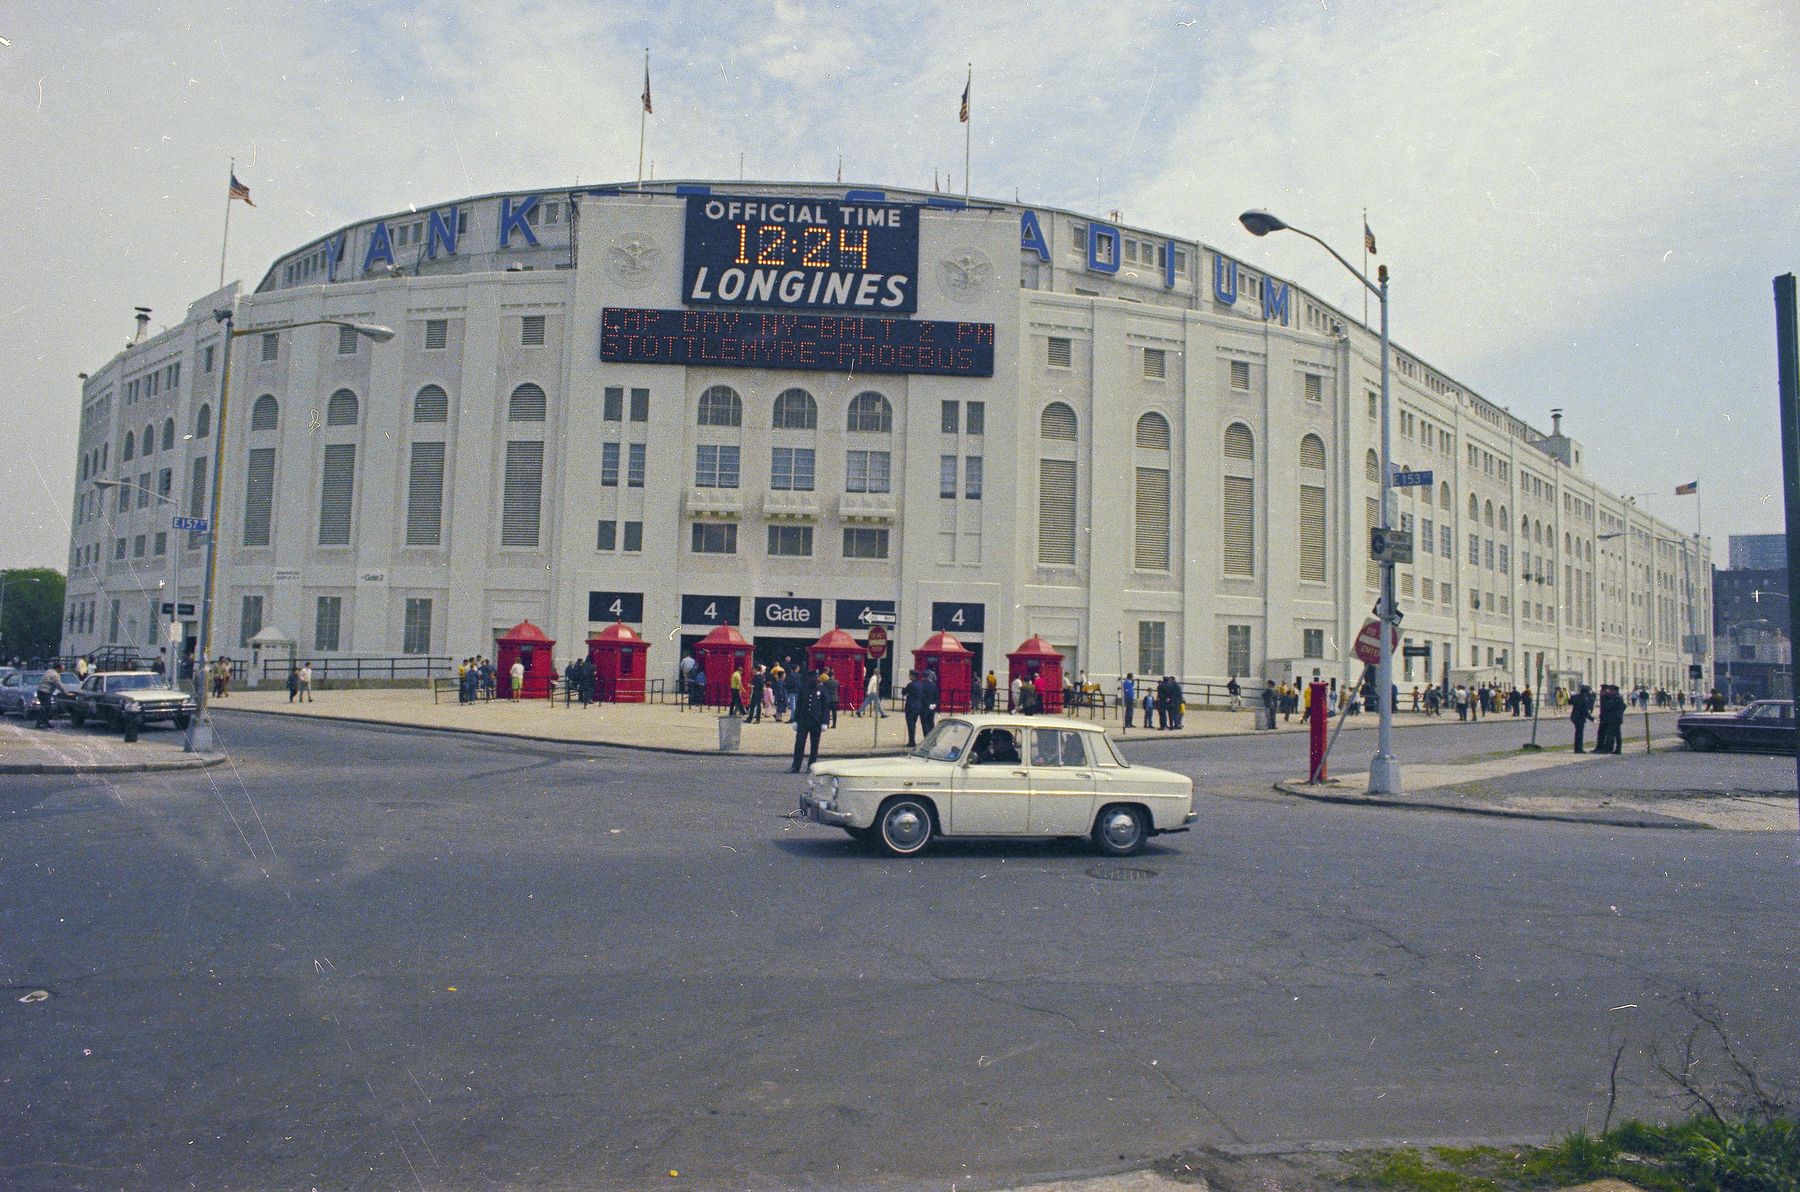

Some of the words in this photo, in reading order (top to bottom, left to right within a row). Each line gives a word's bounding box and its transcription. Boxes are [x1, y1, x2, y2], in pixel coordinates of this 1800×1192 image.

[705, 201, 828, 224] OFFICIAL
[839, 206, 901, 228] TIME
[734, 223, 869, 269] 12:24
[691, 266, 909, 307] LONGINES
[604, 308, 661, 331] CAP
[919, 320, 935, 342] 2
[957, 321, 993, 345] PM
[1402, 473, 1421, 485] 153
[173, 518, 180, 528] E
[181, 518, 199, 529] 157
[608, 598, 623, 616] 4
[703, 602, 718, 619] 4
[765, 604, 811, 622] Gate
[951, 608, 965, 625] 4
[1360, 645, 1381, 657] ENTE
